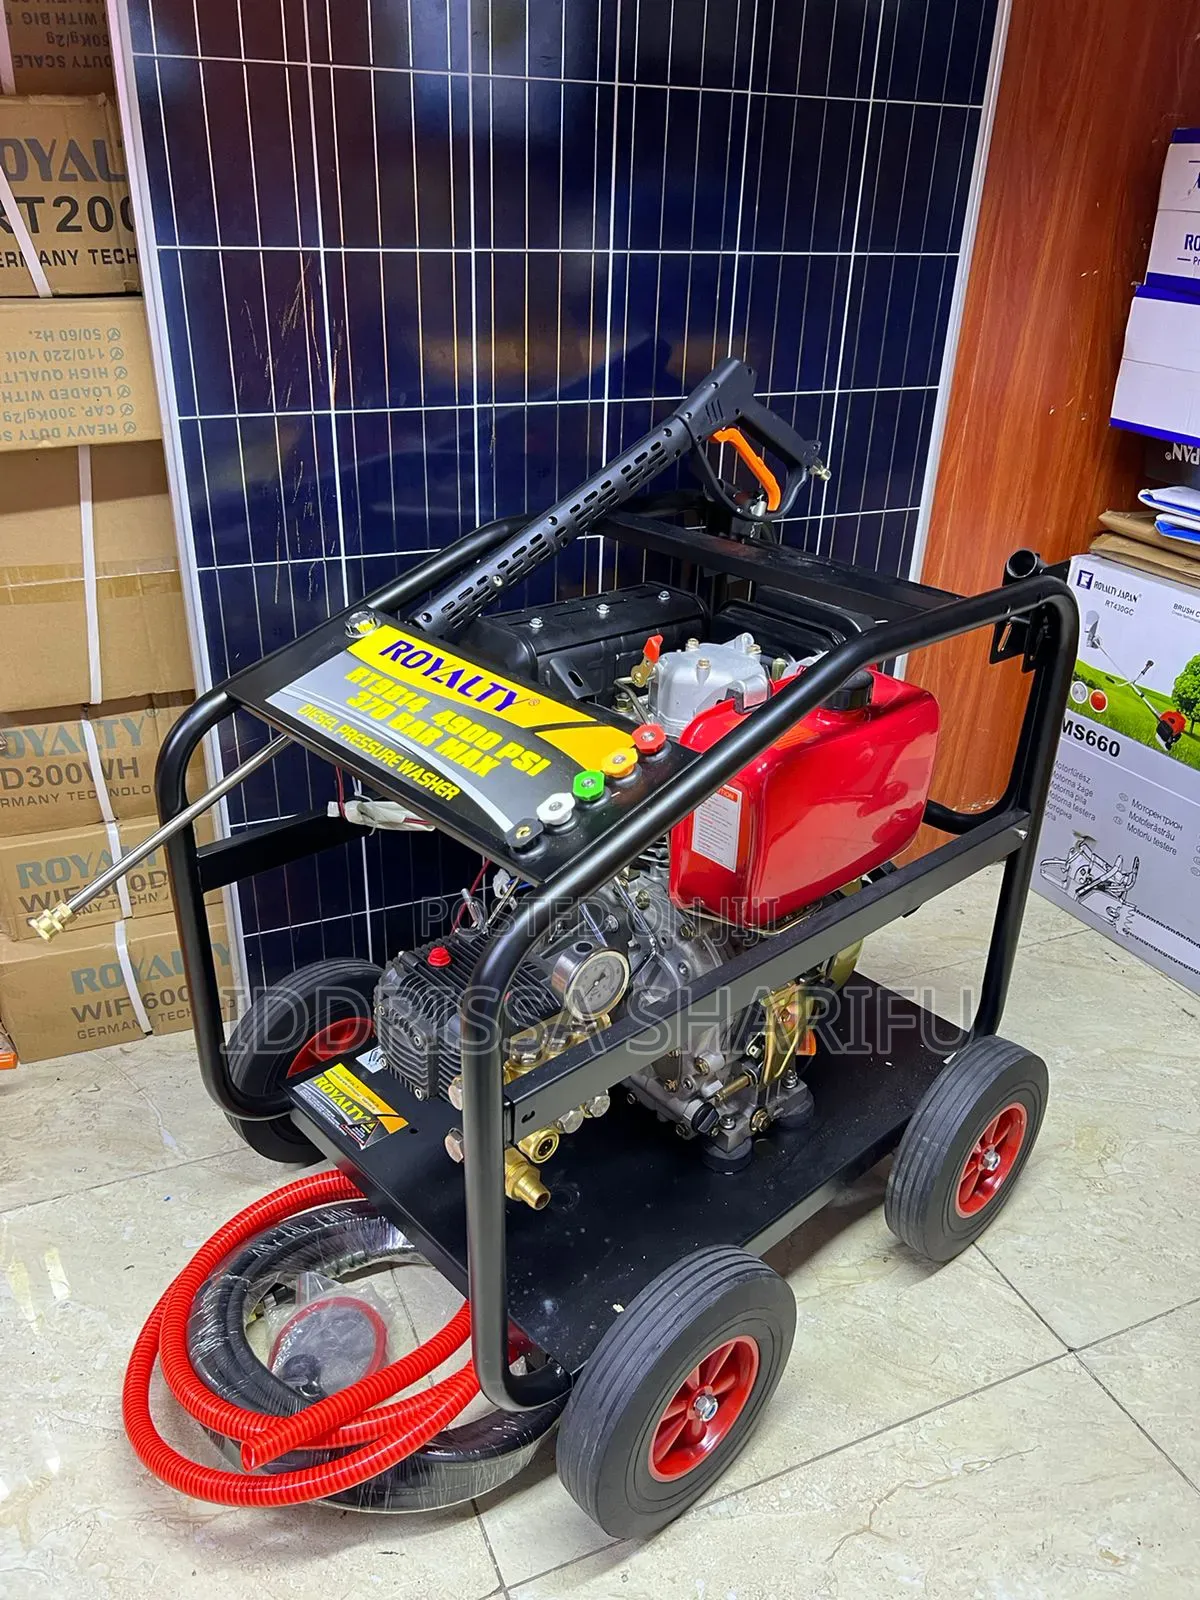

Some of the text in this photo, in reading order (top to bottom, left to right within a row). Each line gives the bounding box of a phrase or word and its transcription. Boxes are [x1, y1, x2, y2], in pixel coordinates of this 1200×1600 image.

[13, 54, 66, 68] SCALE
[59, 328, 101, 342] 50/60
[6, 348, 105, 363] 110/220 Volt
[0, 367, 109, 384] HIGH QUALIT
[1, 386, 113, 403] LOADED WITH
[3, 404, 115, 424] CAP. 300Kg/2g
[19, 427, 61, 442] DUTY
[67, 423, 118, 438] HEAVY
[1117, 590, 1138, 603] JAPAN
[1172, 603, 1195, 616] BRUSH
[378, 639, 528, 712] ROYALTY
[345, 666, 552, 777] RT9814 4900 PSI
[346, 690, 502, 778] 370 BAR MAX
[297, 703, 461, 801] DIESEL PRESSURE WASHER
[1053, 770, 1076, 788] otorna
[67, 785, 152, 801] TECNOLO
[1051, 781, 1074, 799] otorna
[1049, 790, 1072, 808] otorna
[77, 1014, 151, 1040] GERMAN
[312, 1076, 367, 1121] ROYALTY
